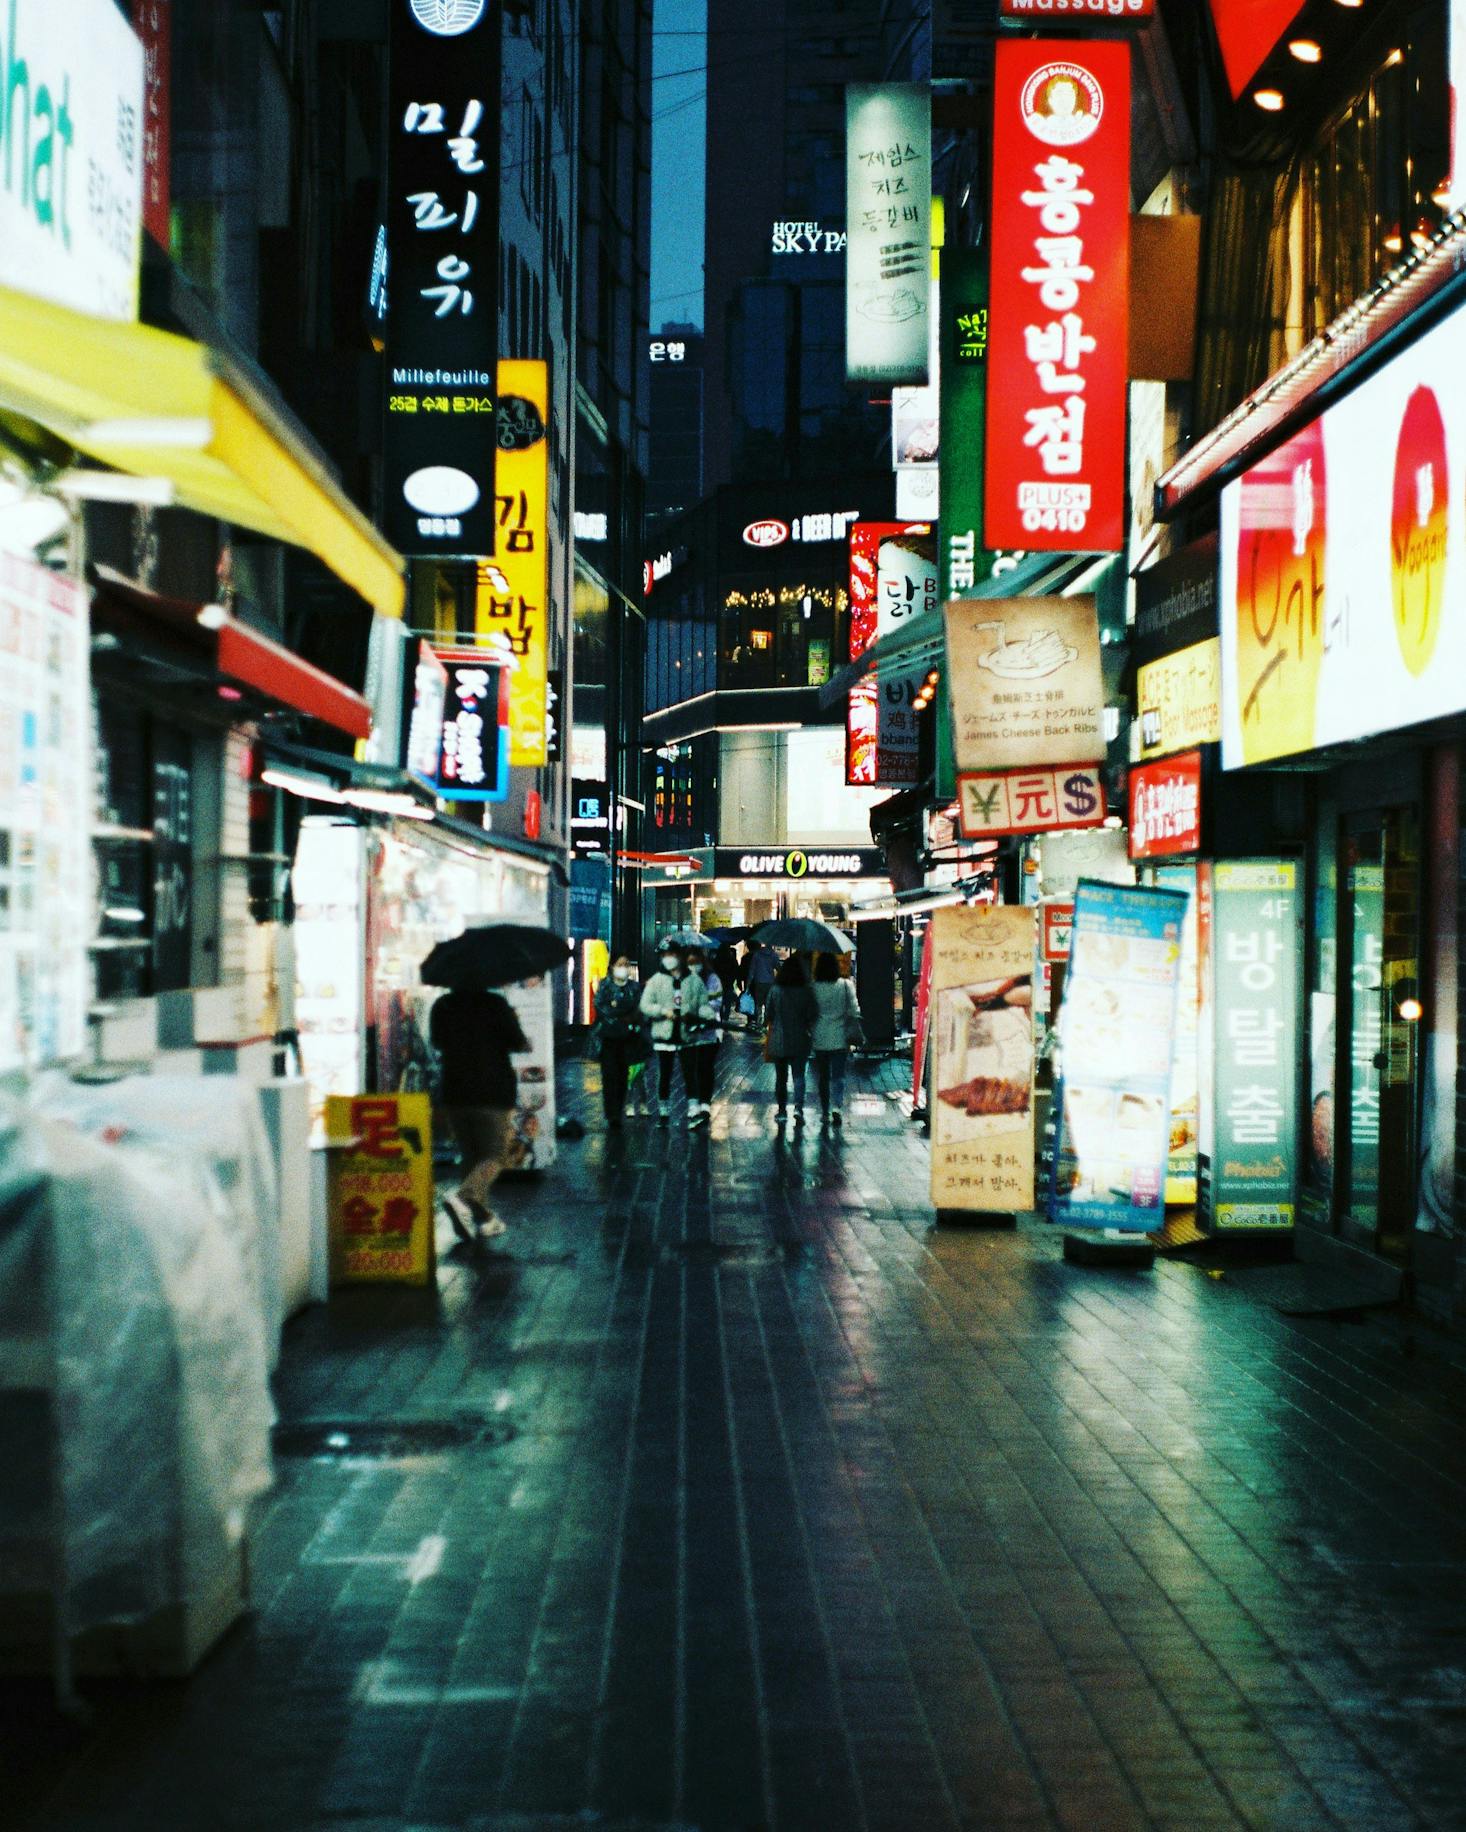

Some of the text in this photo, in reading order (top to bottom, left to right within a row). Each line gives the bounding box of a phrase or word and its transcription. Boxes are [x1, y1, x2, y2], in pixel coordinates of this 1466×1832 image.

[872, 177, 908, 194] 치즈
[772, 221, 822, 233] HOTEL
[862, 205, 919, 233] 등갈비
[1019, 154, 1096, 475] 홍콩반점
[649, 342, 686, 362] 은행
[392, 368, 489, 385] Millefeuille
[1022, 487, 1086, 504] PLUS+
[1022, 508, 1087, 532] 0410
[964, 723, 1098, 741] James Cheese Back Ribs
[1016, 779, 1052, 820] 元
[740, 855, 862, 873] OLIVE YOUNG
[1260, 899, 1289, 919] 4F
[1226, 930, 1285, 1144] 방탈출
